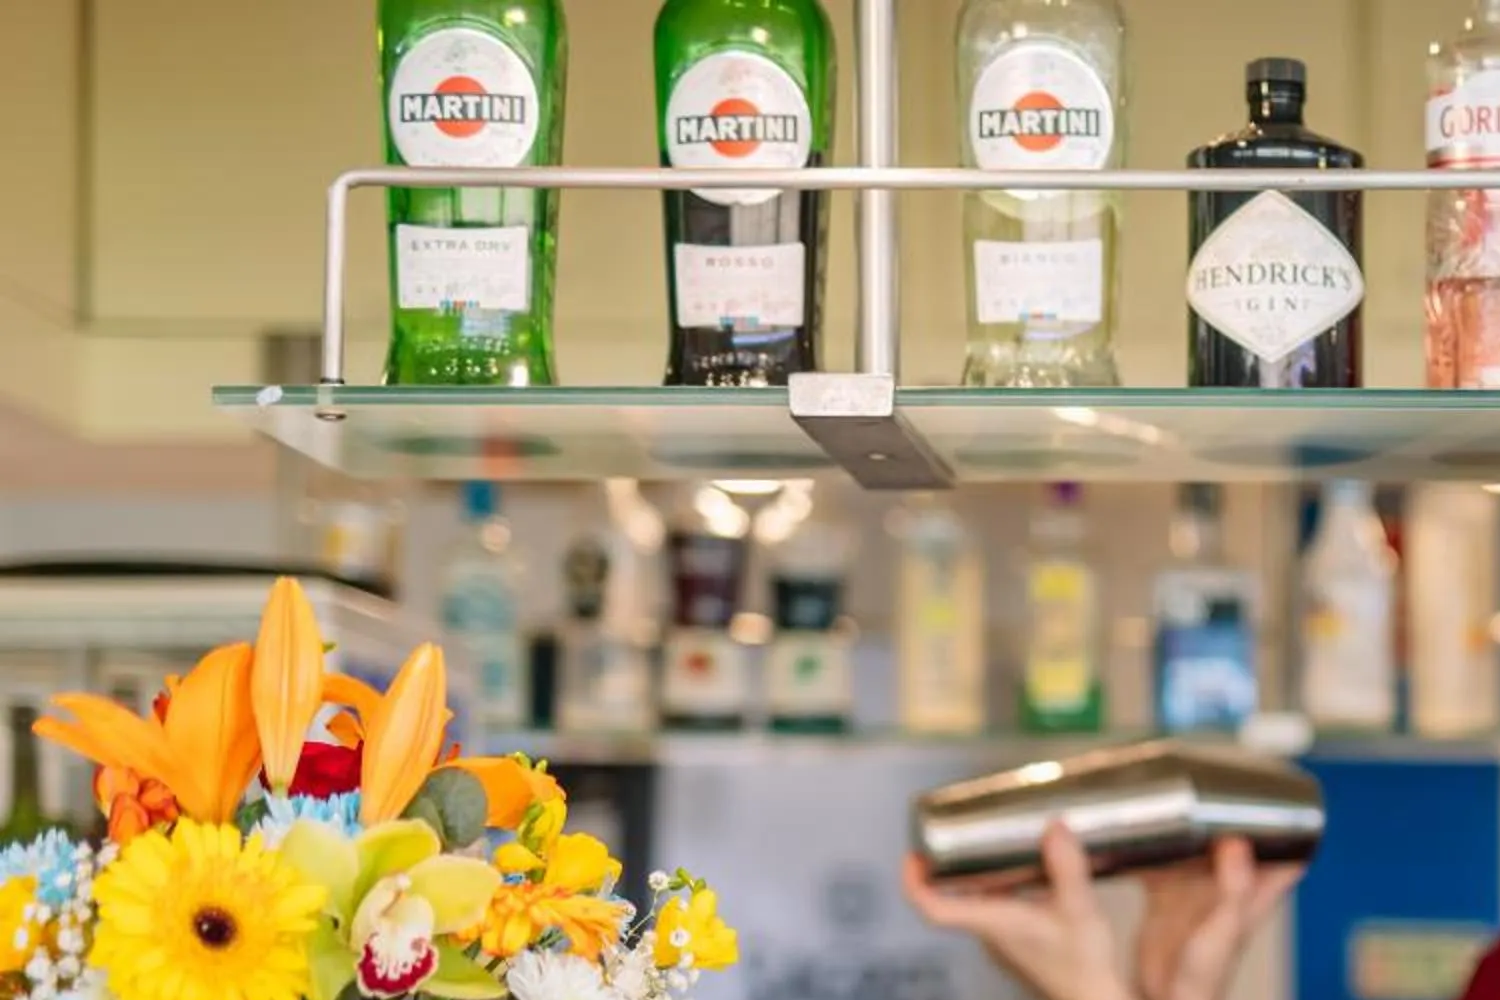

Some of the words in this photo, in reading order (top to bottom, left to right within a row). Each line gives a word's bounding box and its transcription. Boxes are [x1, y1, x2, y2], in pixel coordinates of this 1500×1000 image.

[402, 95, 524, 122] MARTINI
[678, 115, 798, 144] MARTINI
[980, 109, 1099, 138] MARTINI
[411, 239, 470, 252] EXTRA
[474, 239, 511, 251] DRY
[1195, 262, 1353, 293] HENDRICK'S
[1246, 296, 1298, 311] GIN
